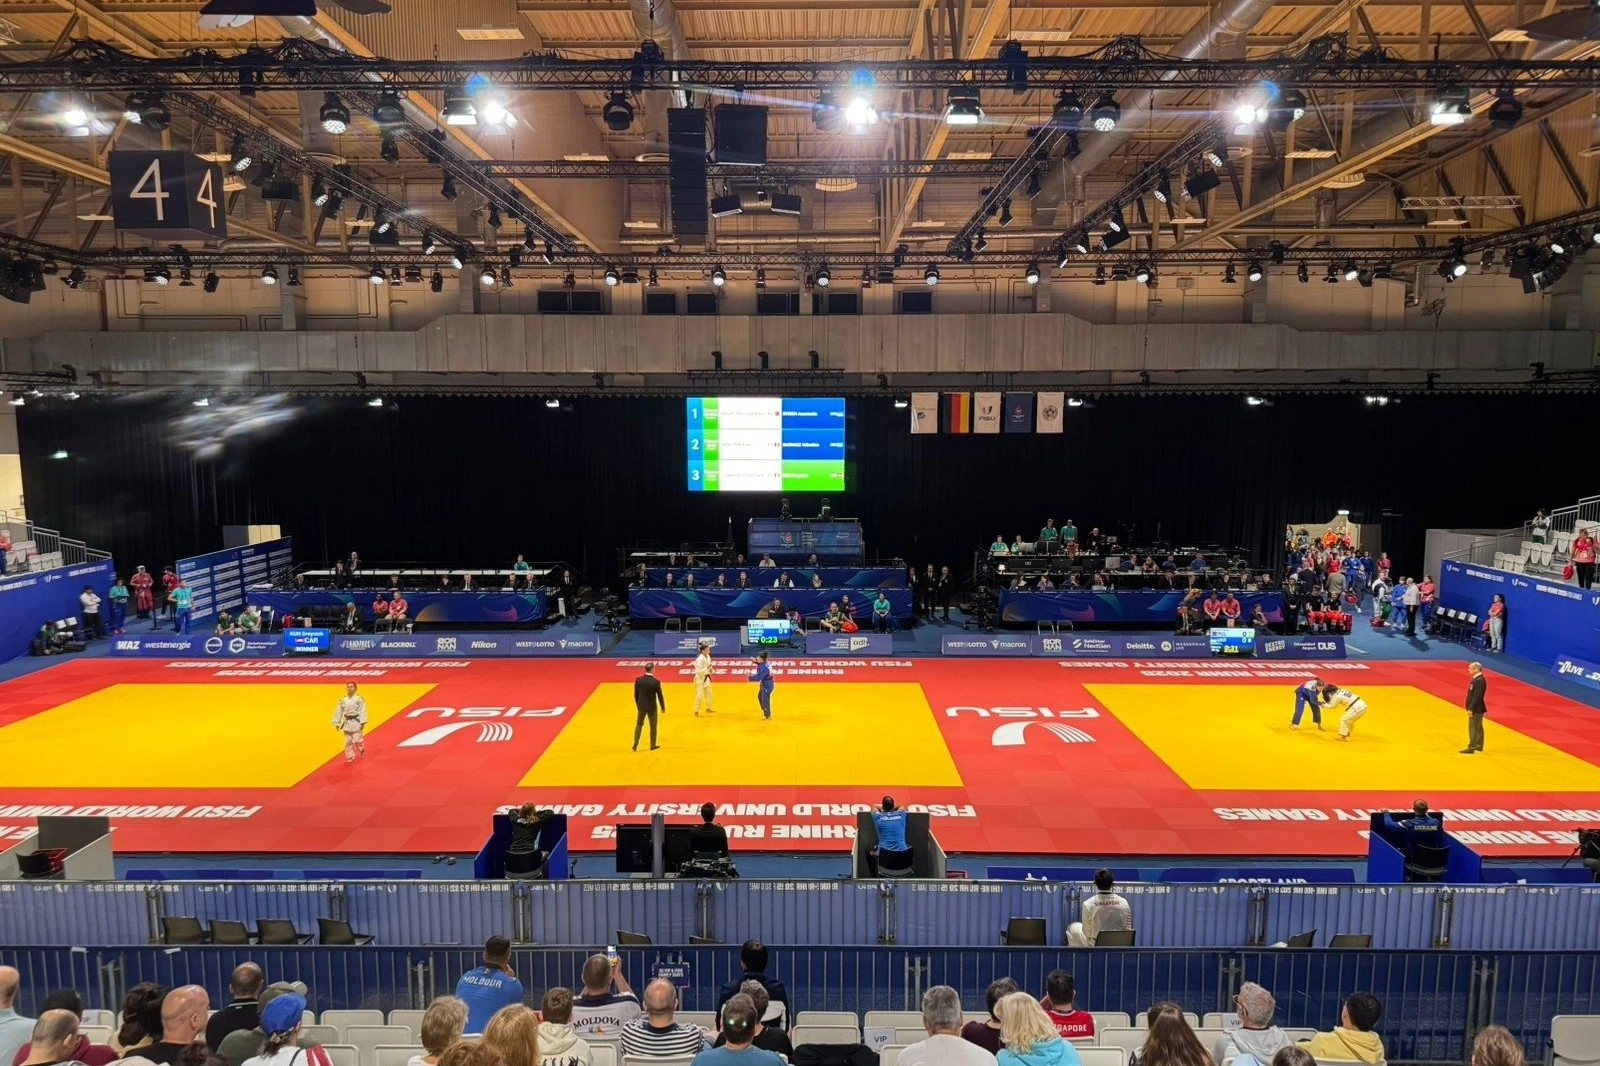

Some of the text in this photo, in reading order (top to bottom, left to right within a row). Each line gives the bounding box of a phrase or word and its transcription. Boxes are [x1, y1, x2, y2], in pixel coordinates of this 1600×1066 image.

[130, 159, 169, 220] 4
[197, 169, 217, 228] 4
[692, 408, 698, 419] 1
[691, 439, 699, 450] 2
[691, 470, 700, 481] 3
[116, 640, 140, 650] WAZ
[145, 641, 192, 651] westenergie
[760, 636, 778, 644] 0:23
[1317, 642, 1337, 650] DUS
[406, 706, 568, 718] FISU
[945, 706, 1100, 718] FISU
[66, 805, 188, 818] WORLD
[181, 805, 263, 818] FISU
[606, 804, 786, 817] UNIVRSITY
[1213, 808, 1330, 821] GAMES
[772, 825, 857, 839] RHINE
[573, 1016, 621, 1029] MOLDOVA
[874, 1035, 888, 1043] VIP
